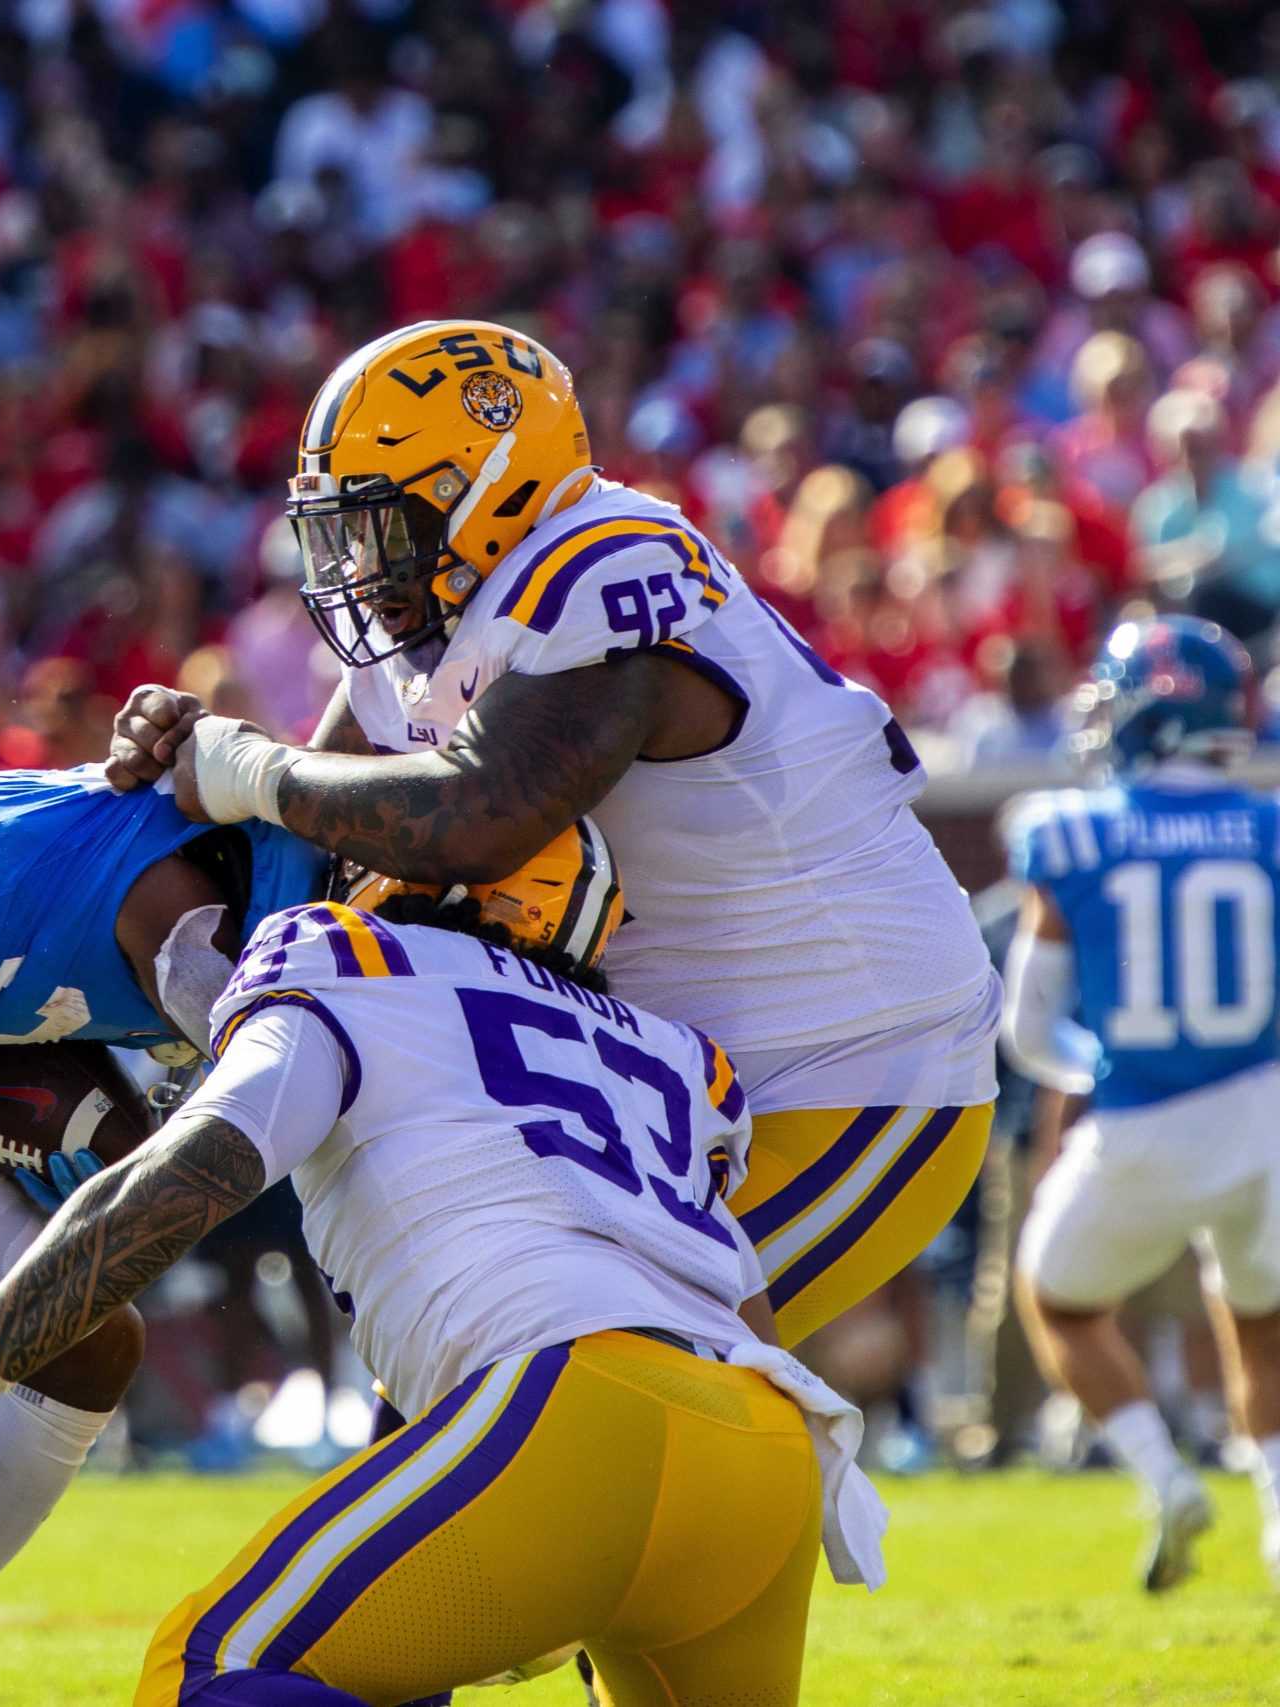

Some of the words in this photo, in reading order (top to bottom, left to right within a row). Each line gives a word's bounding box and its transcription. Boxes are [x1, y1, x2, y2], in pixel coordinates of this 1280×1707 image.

[388, 333, 544, 398] LSU
[600, 573, 687, 658] 92
[1099, 860, 1275, 1048] 10
[454, 987, 739, 1252] 53
